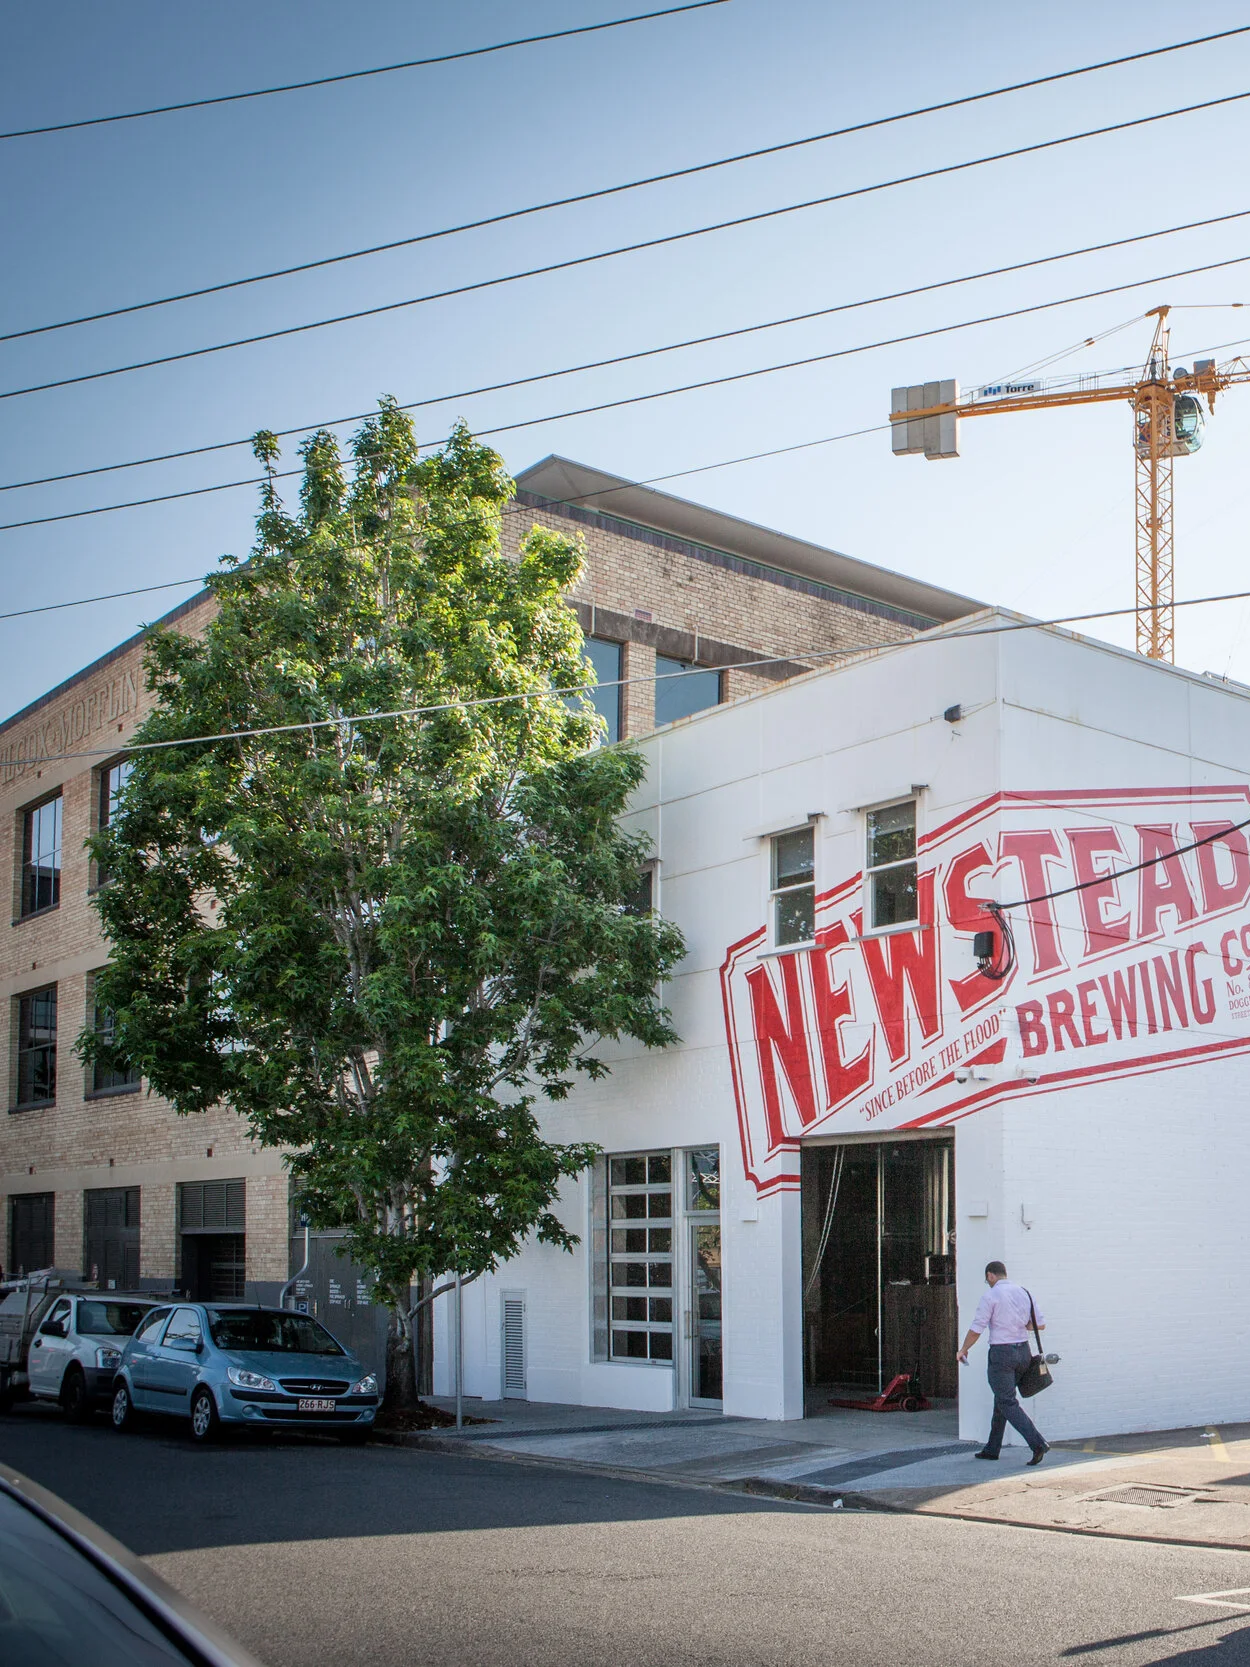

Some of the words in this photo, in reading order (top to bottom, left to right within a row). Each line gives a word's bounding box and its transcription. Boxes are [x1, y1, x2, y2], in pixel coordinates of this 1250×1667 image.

[1005, 384, 1034, 394] Torre
[57, 667, 139, 753] MOFFLIN
[1015, 941, 1217, 1058] BREWING
[1226, 978, 1244, 998] No.
[1232, 1010, 1250, 1020] STREET
[895, 1056, 938, 1101] BEFORE
[939, 1039, 962, 1070] THE
